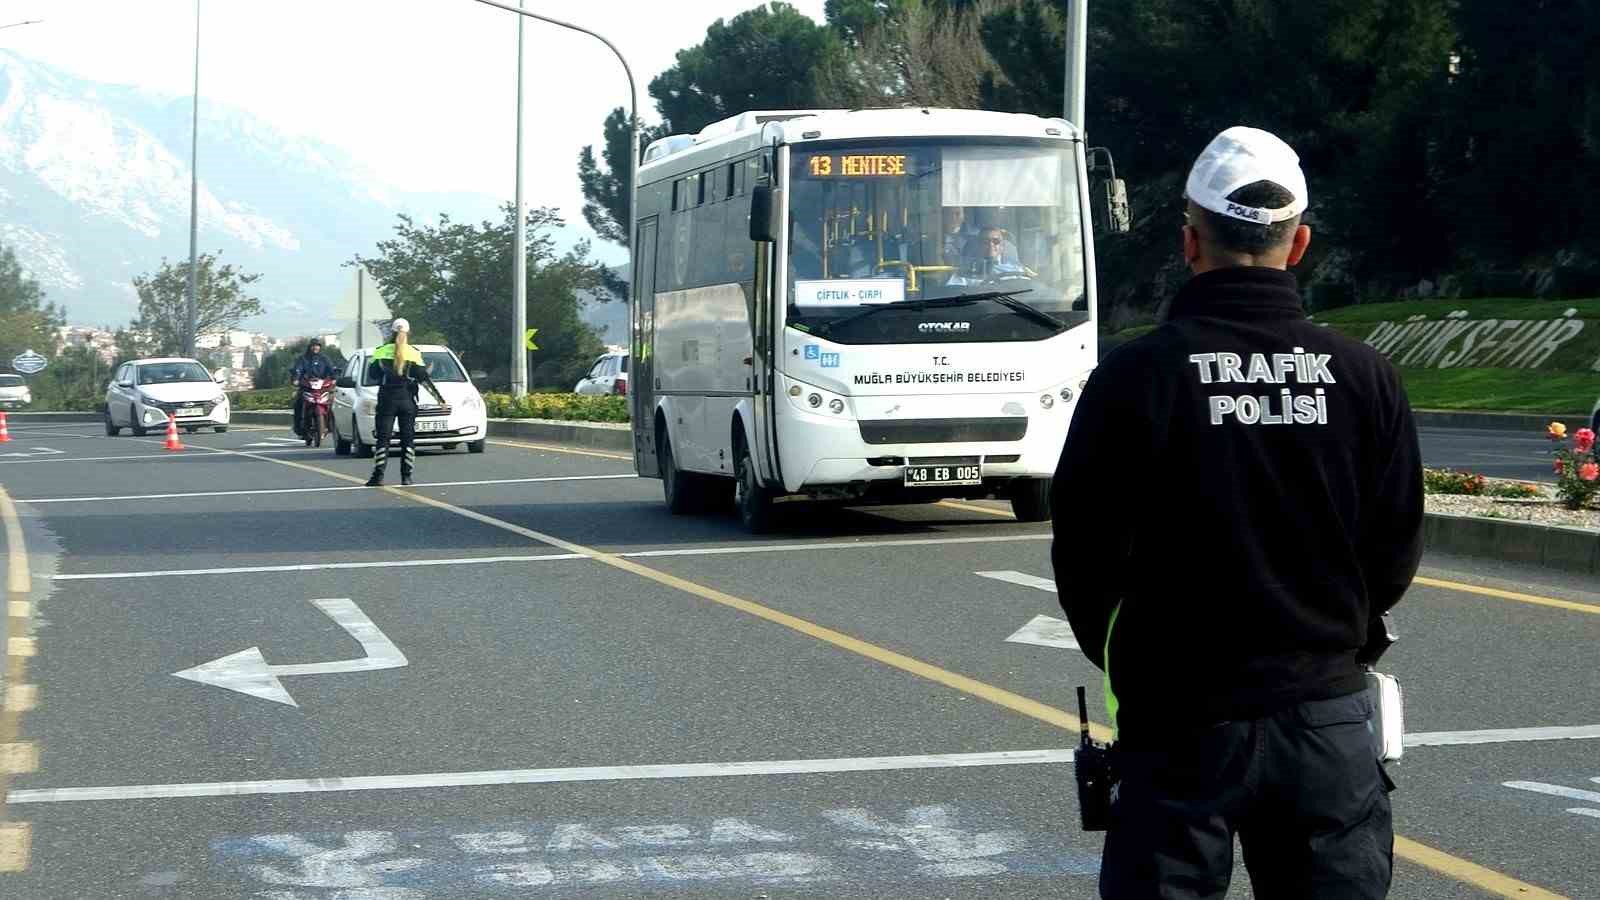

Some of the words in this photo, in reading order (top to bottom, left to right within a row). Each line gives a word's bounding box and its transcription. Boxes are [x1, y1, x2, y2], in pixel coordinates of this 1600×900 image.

[809, 155, 832, 176] 13
[918, 321, 970, 333] OTOKAR
[1189, 347, 1336, 384] TRAFİK
[854, 371, 892, 385] MUĞLA
[967, 369, 1025, 383] BELEDİYESİ
[1208, 388, 1328, 425] POLİSİ
[913, 468, 928, 481] 48
[935, 467, 950, 481] EB
[957, 466, 979, 480] 005
